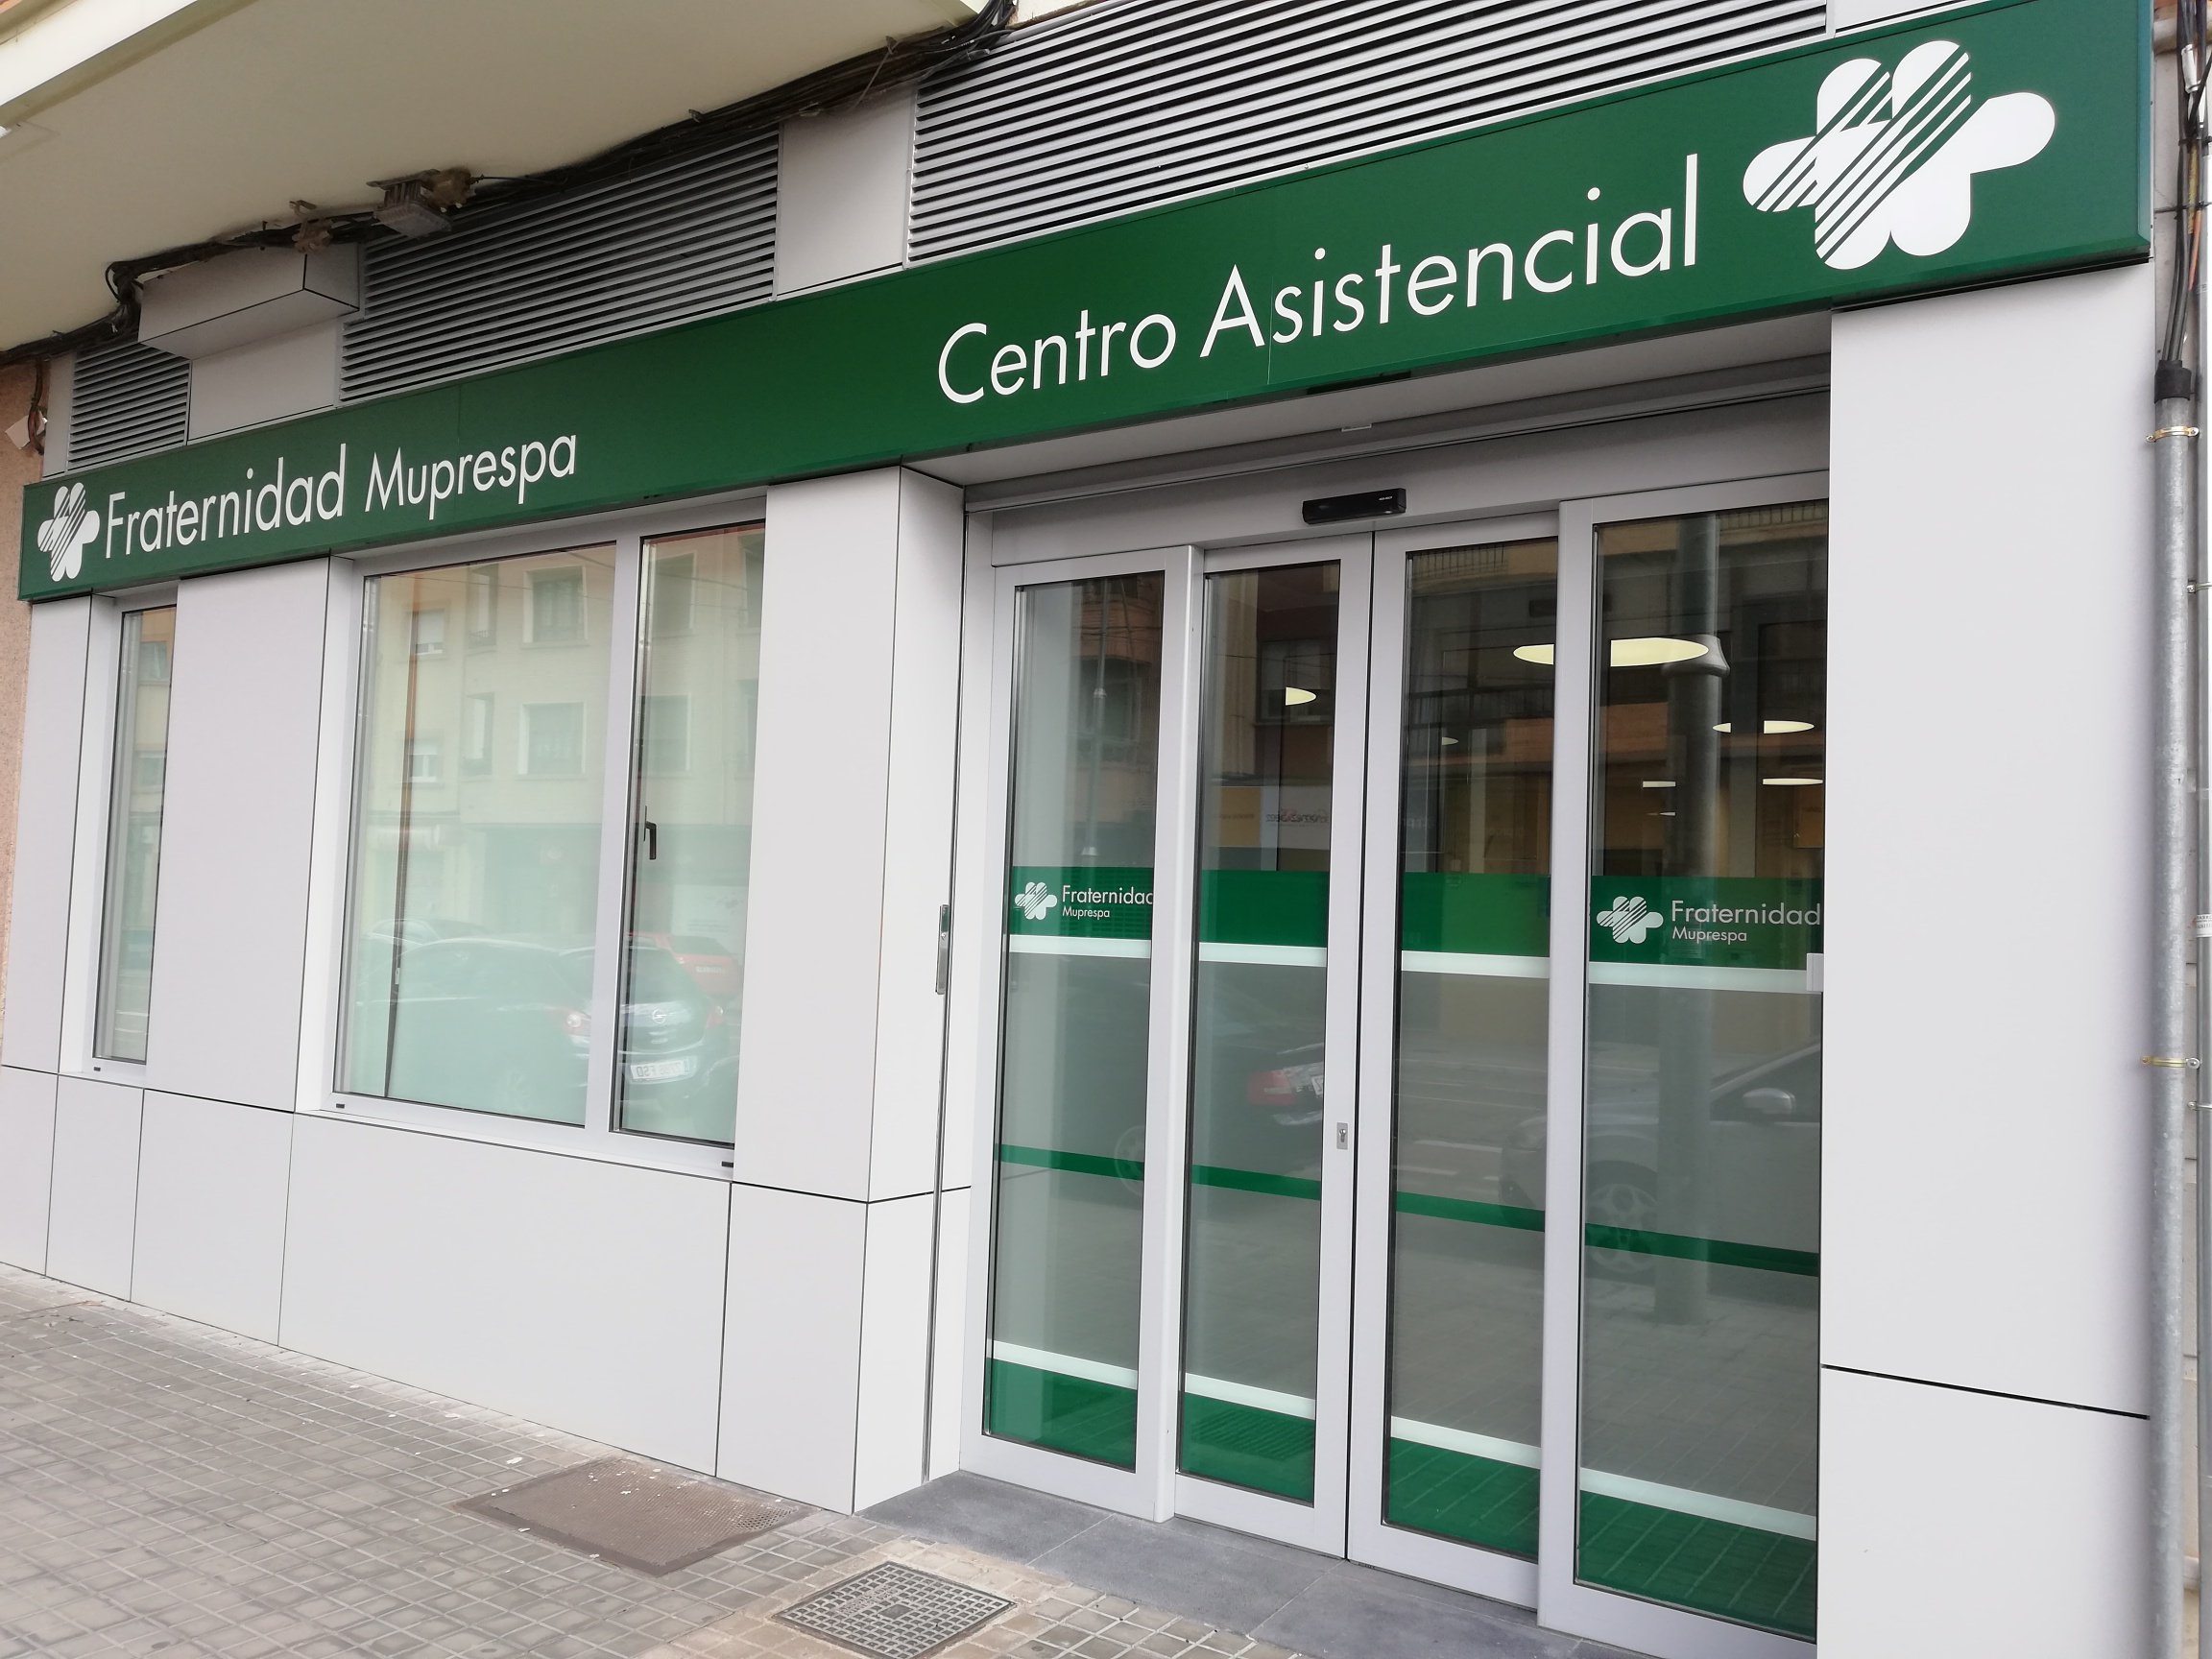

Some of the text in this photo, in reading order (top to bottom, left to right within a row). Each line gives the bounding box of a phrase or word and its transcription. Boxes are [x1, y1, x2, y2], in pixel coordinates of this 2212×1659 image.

[938, 153, 1698, 404] Centro Asistencial
[106, 434, 577, 559] Fraternidad Muprespa
[1062, 906, 1111, 921] Muprespa
[1671, 900, 1820, 926] Fraternidad
[1671, 926, 1747, 946] Muprespa
